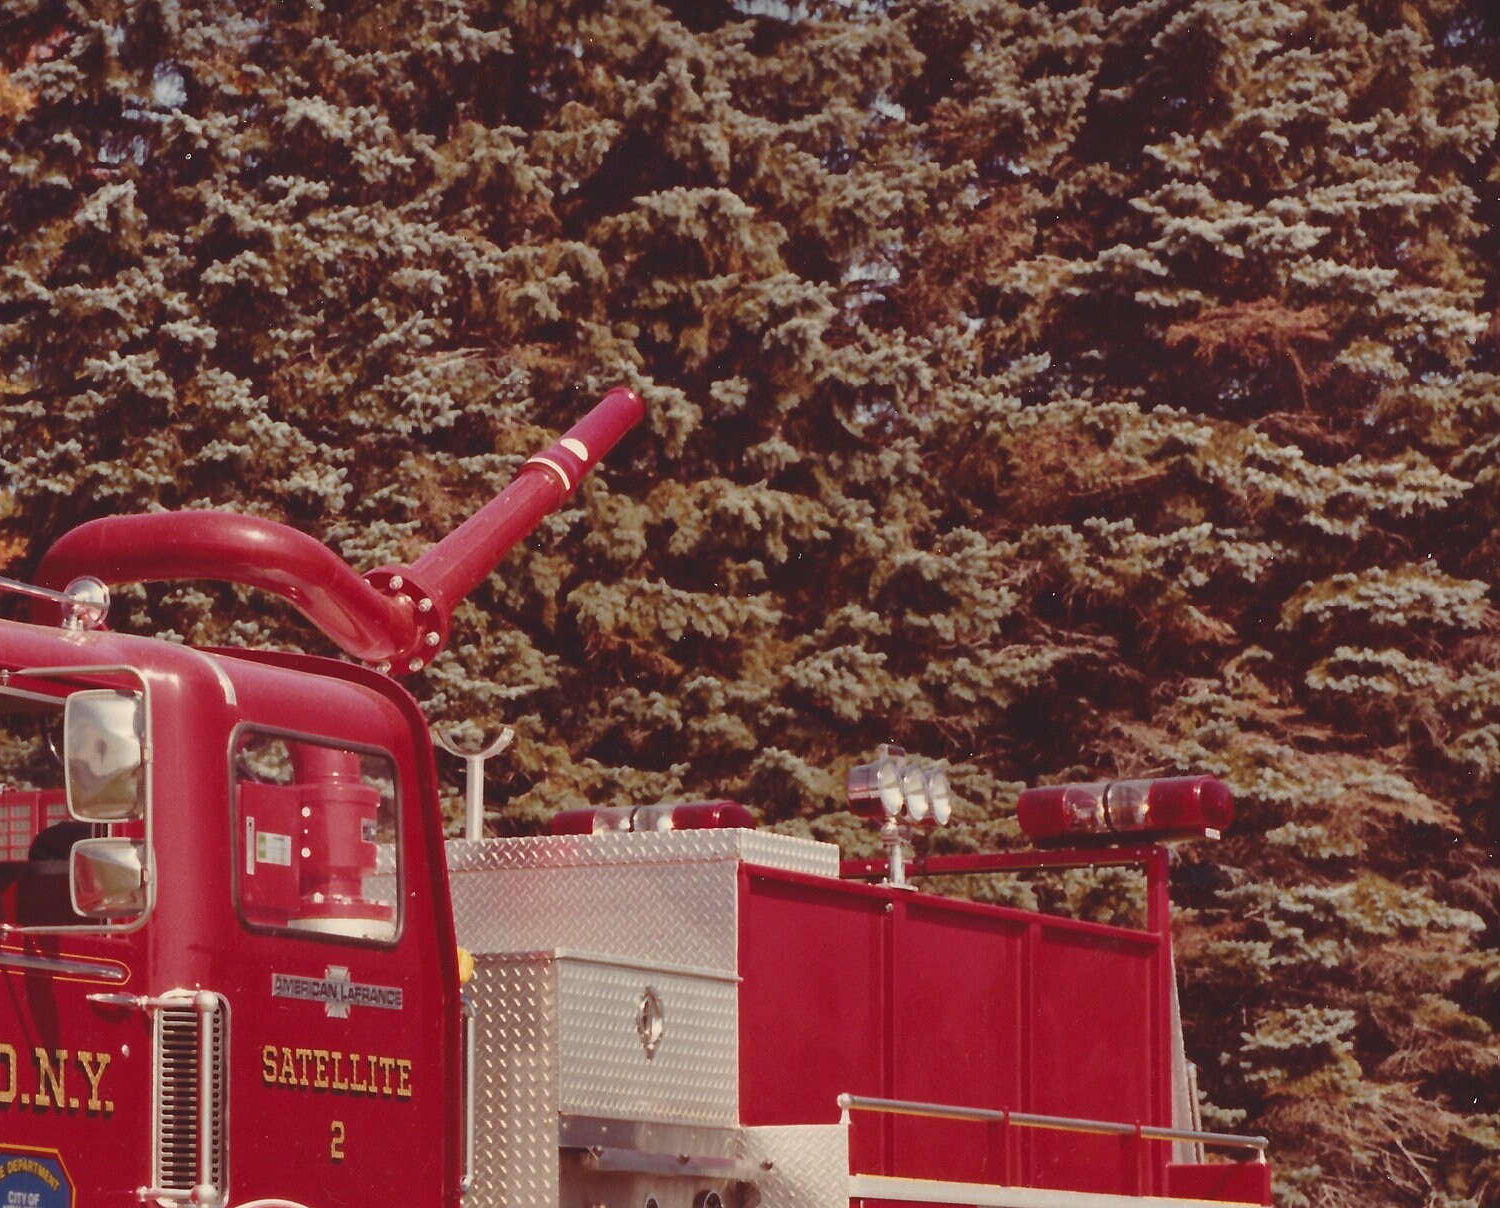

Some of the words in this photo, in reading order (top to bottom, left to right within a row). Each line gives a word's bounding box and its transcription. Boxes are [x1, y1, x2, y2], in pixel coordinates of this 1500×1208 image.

[274, 975, 337, 998] AMERICAN
[262, 1045, 412, 1096] SATELLITE
[330, 1120, 345, 1159] 2
[7, 1158, 60, 1191] DEPARTMENT
[8, 1190, 26, 1205] CITY
[28, 1192, 40, 1206] OF
